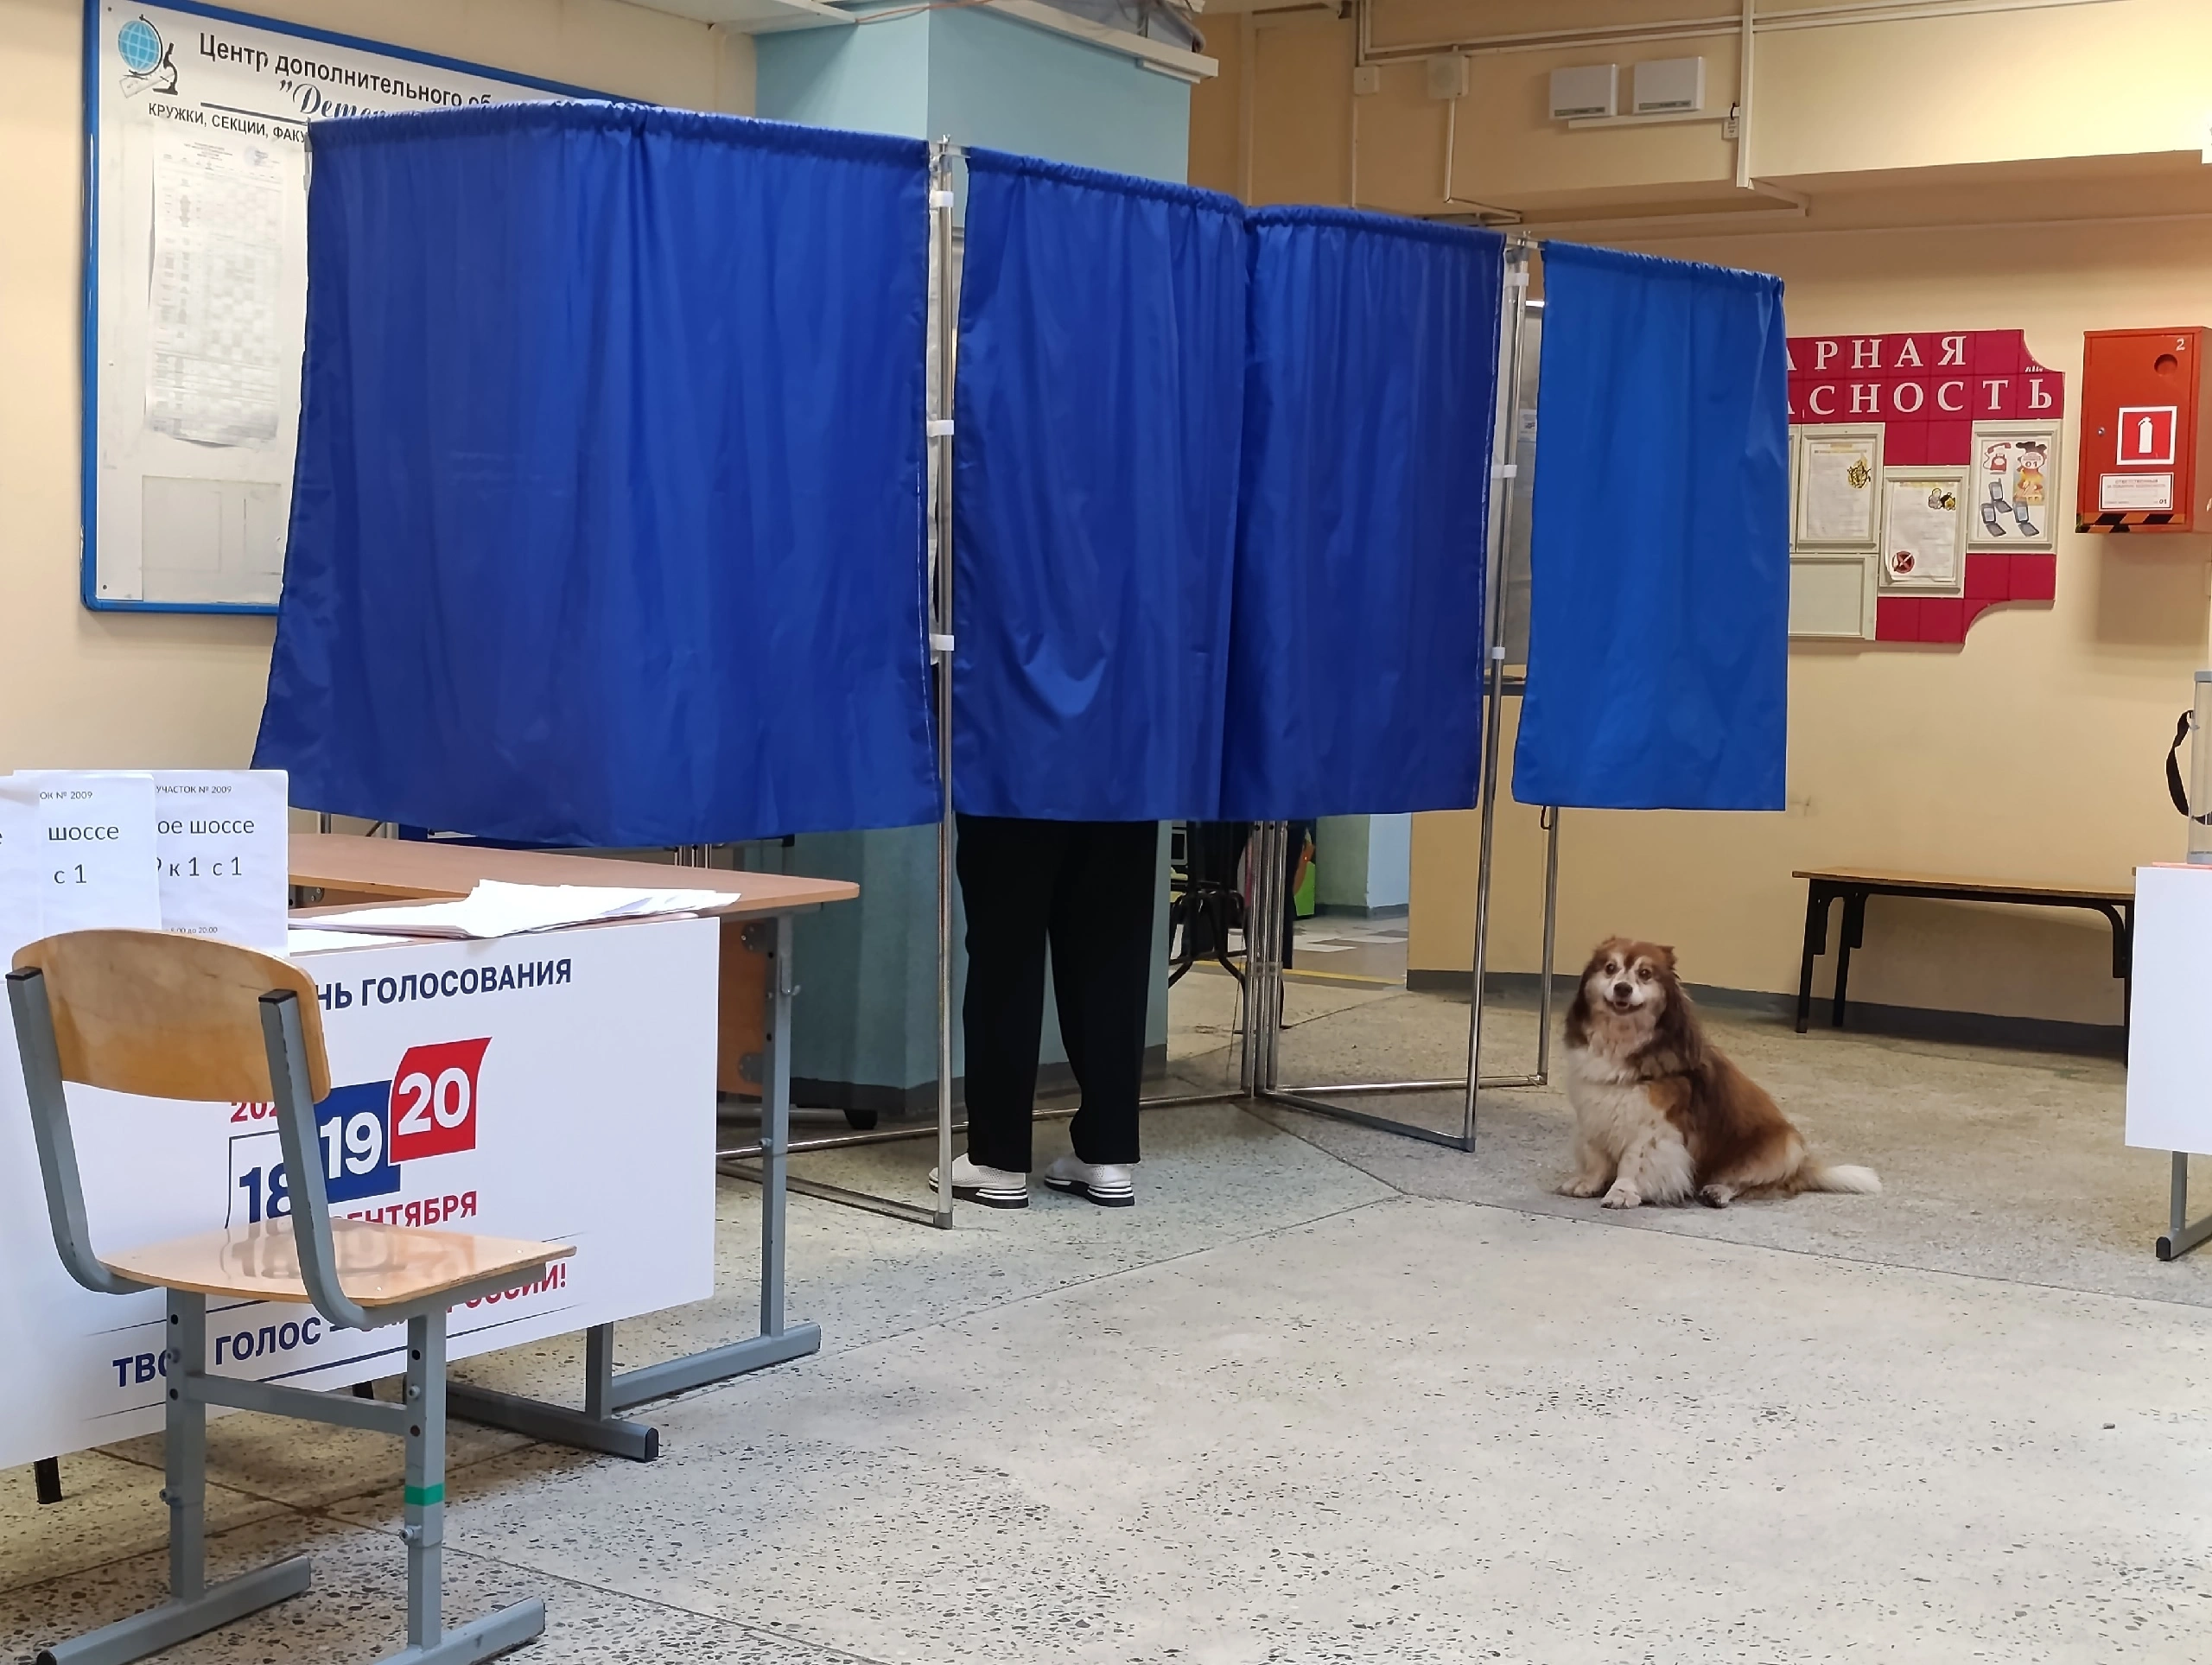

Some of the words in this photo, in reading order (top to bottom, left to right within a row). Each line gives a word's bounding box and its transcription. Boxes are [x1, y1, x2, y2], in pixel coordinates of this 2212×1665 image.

[200, 32, 269, 72] Центр
[275, 55, 462, 107] дополнительного
[149, 102, 207, 127] КРУЖКИ,
[212, 114, 269, 138] СЕКЦИИ,
[2176, 338, 2186, 351] 2
[1787, 378, 2053, 416] СНОСТЬ
[156, 785, 196, 794] УЧАСТОК
[48, 826, 119, 841] шоссе
[190, 819, 255, 834] шоссе
[54, 870, 65, 884] с
[74, 864, 87, 883] 1
[169, 863, 180, 876] к
[188, 856, 200, 876] 1
[213, 862, 223, 875] с
[231, 856, 242, 875] 1
[361, 958, 572, 1007] ГОЛОСОВАНИЯ
[397, 1067, 471, 1137] 20
[320, 1111, 383, 1180] 19
[215, 1317, 321, 1365] ГОЛОС
